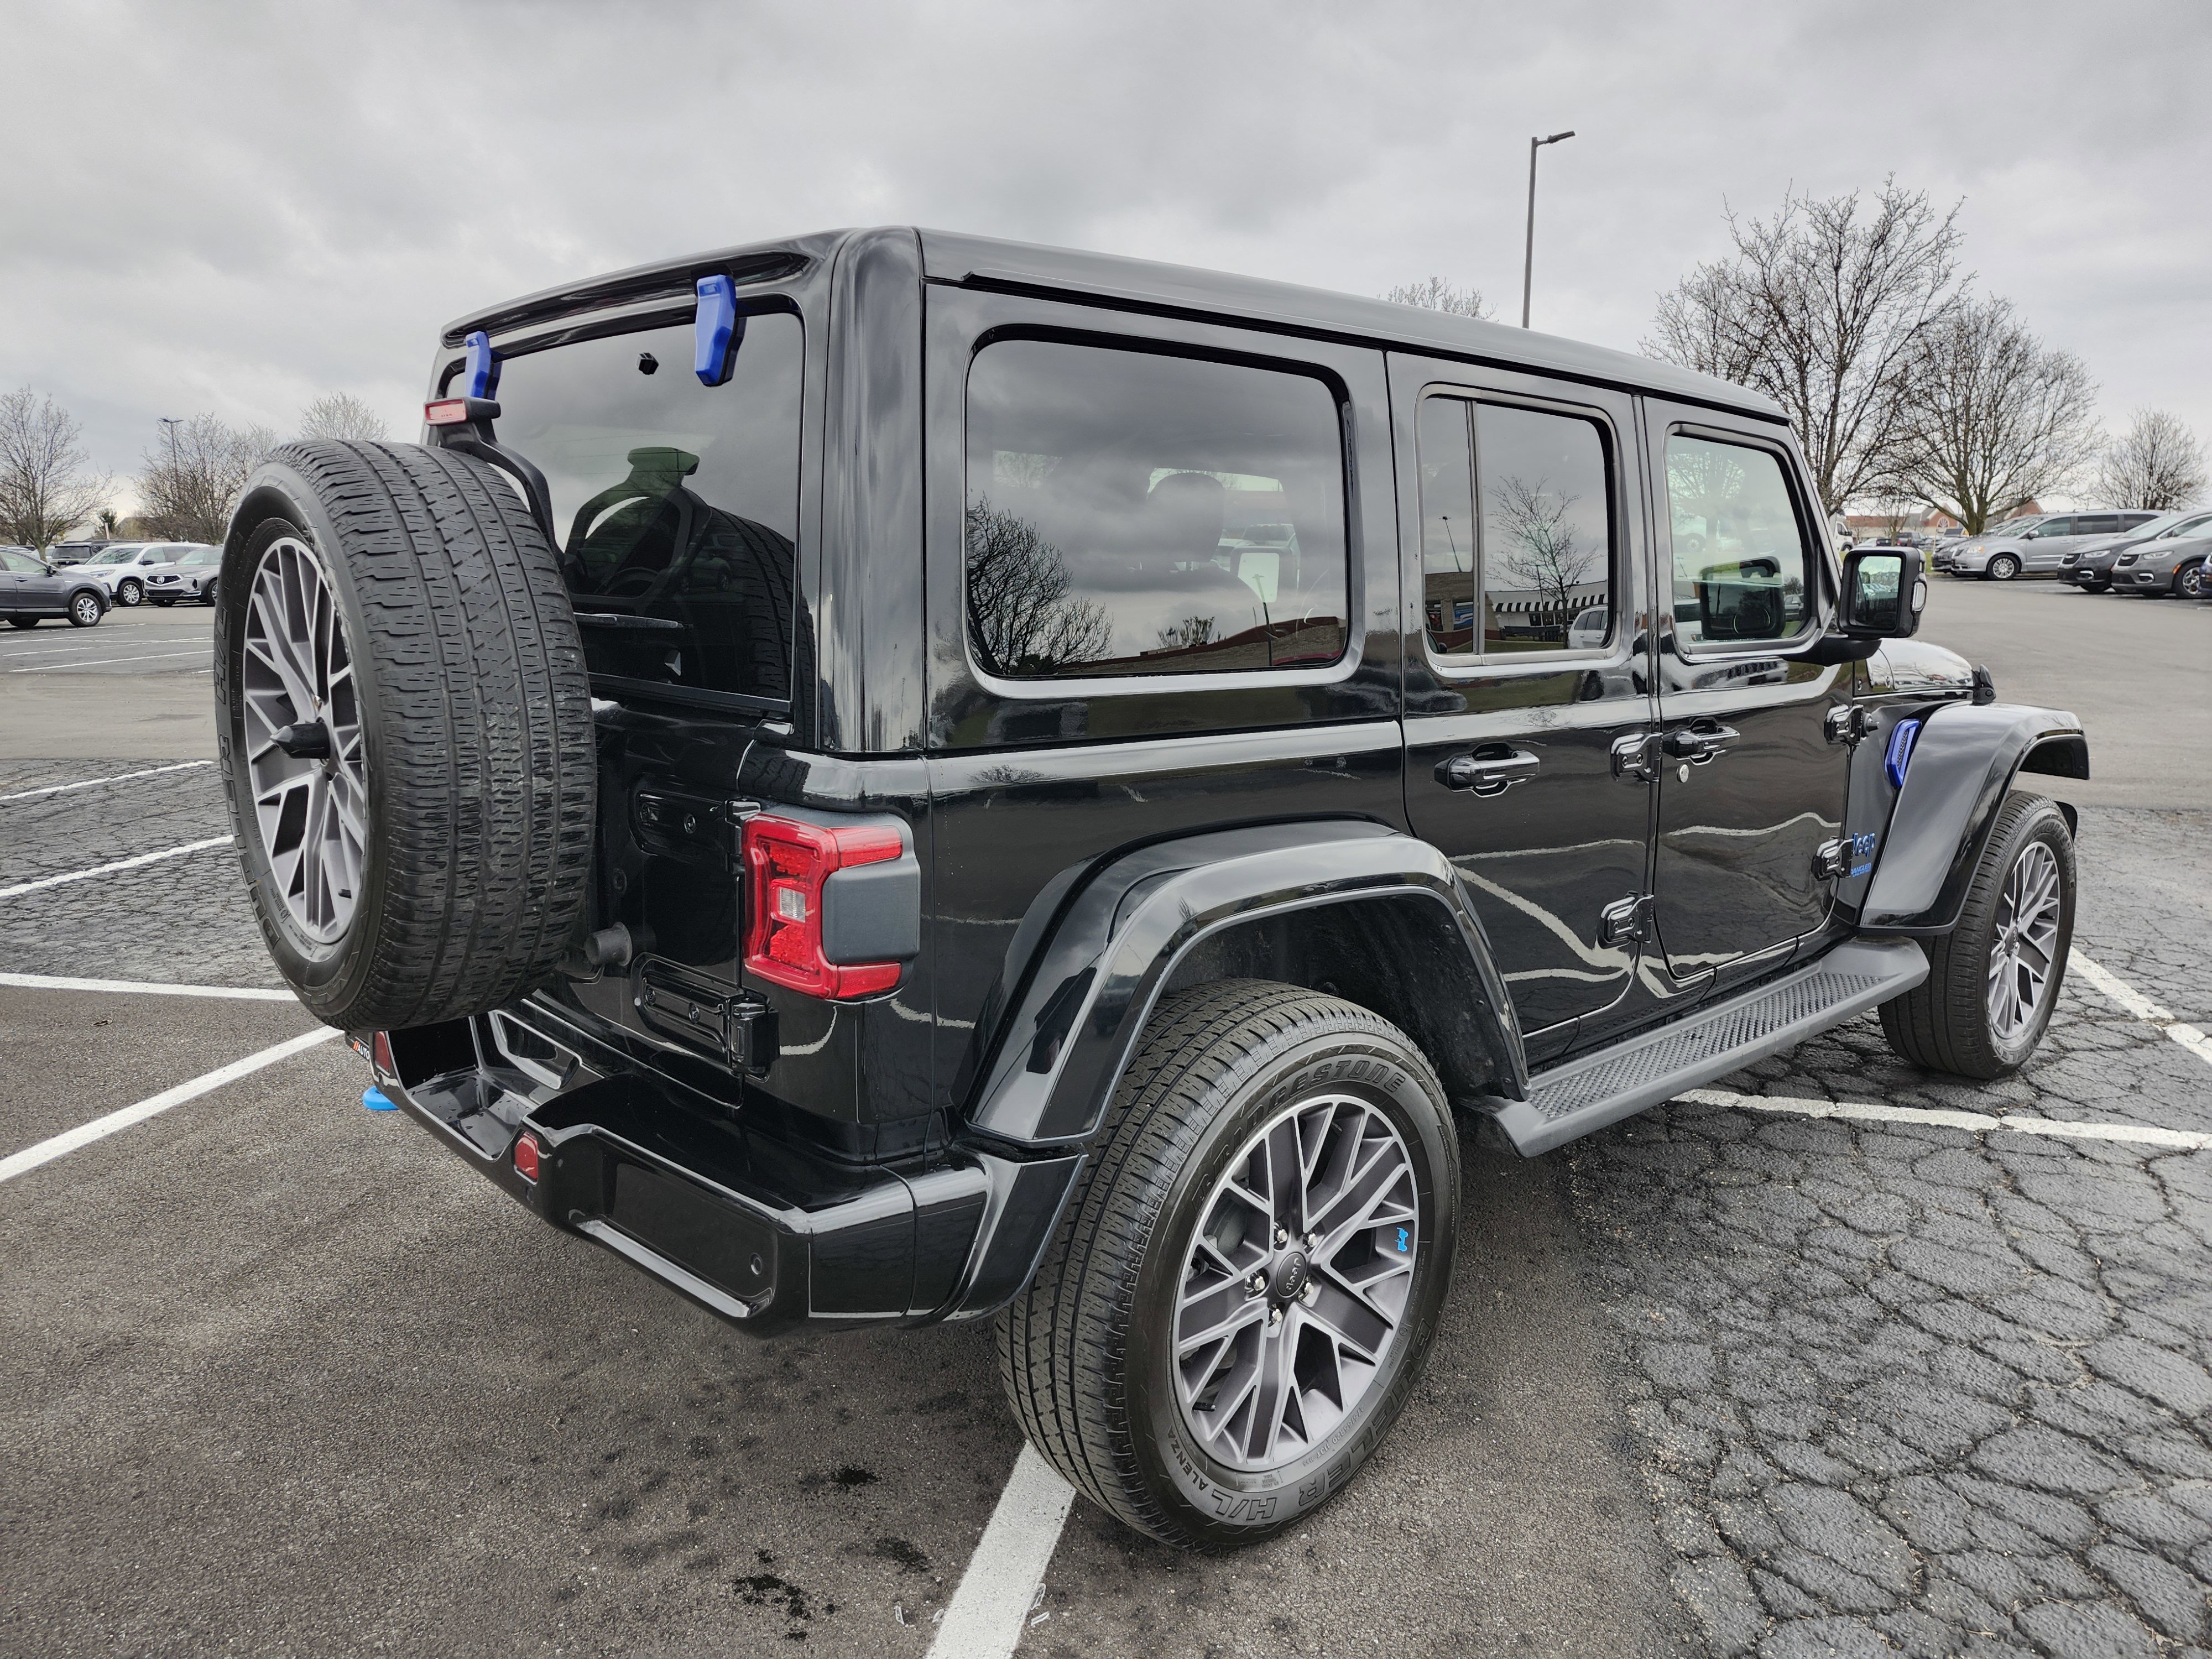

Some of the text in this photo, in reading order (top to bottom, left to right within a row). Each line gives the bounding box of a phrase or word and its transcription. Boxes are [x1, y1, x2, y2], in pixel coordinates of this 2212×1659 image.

[219, 734, 280, 950] DUELER
[1192, 1060, 1406, 1209] BRIDGESTONE
[1285, 1257, 1301, 1290] Jeep
[1298, 1318, 1432, 1506] DUELER
[1332, 1405, 1365, 1444] 275/55R20
[1168, 1425, 1209, 1491] ALENZA
[1211, 1489, 1277, 1521] H/L
